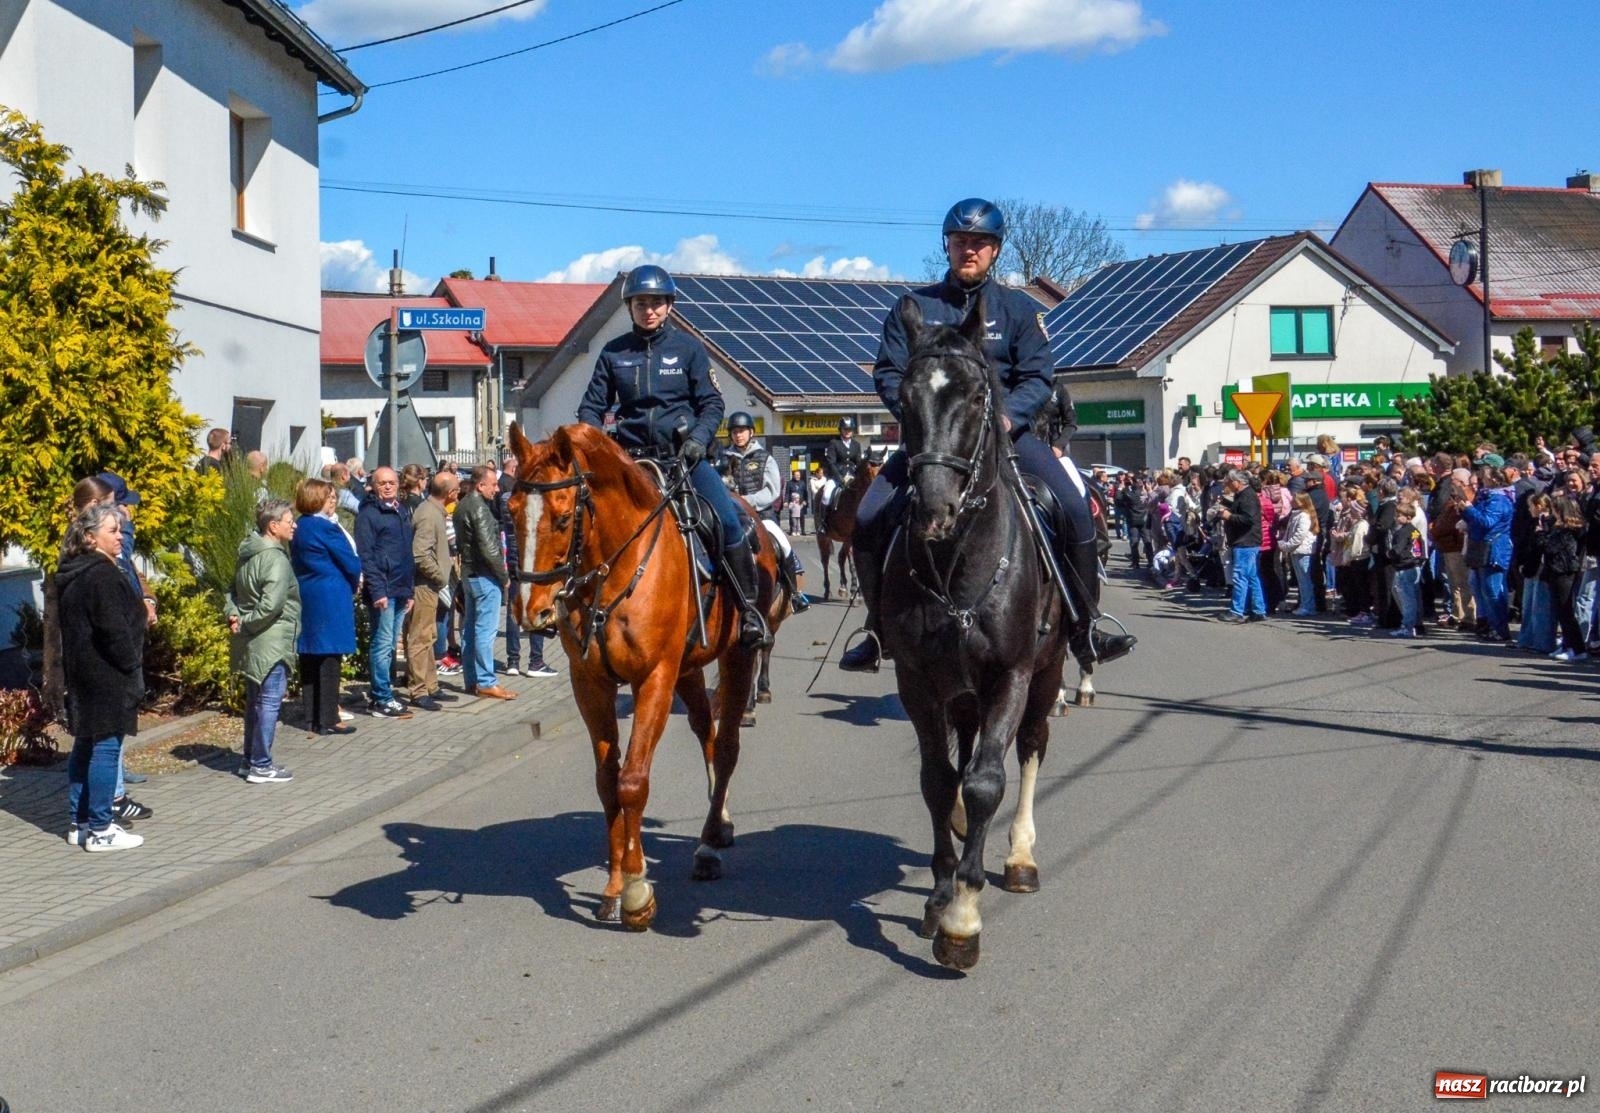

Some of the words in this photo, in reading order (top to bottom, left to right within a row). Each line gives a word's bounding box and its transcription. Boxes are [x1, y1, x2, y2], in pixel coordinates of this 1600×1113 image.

[659, 368, 683, 376] POLICJA
[1291, 392, 1372, 409] APTEKA
[1107, 409, 1136, 419] ZIELONA
